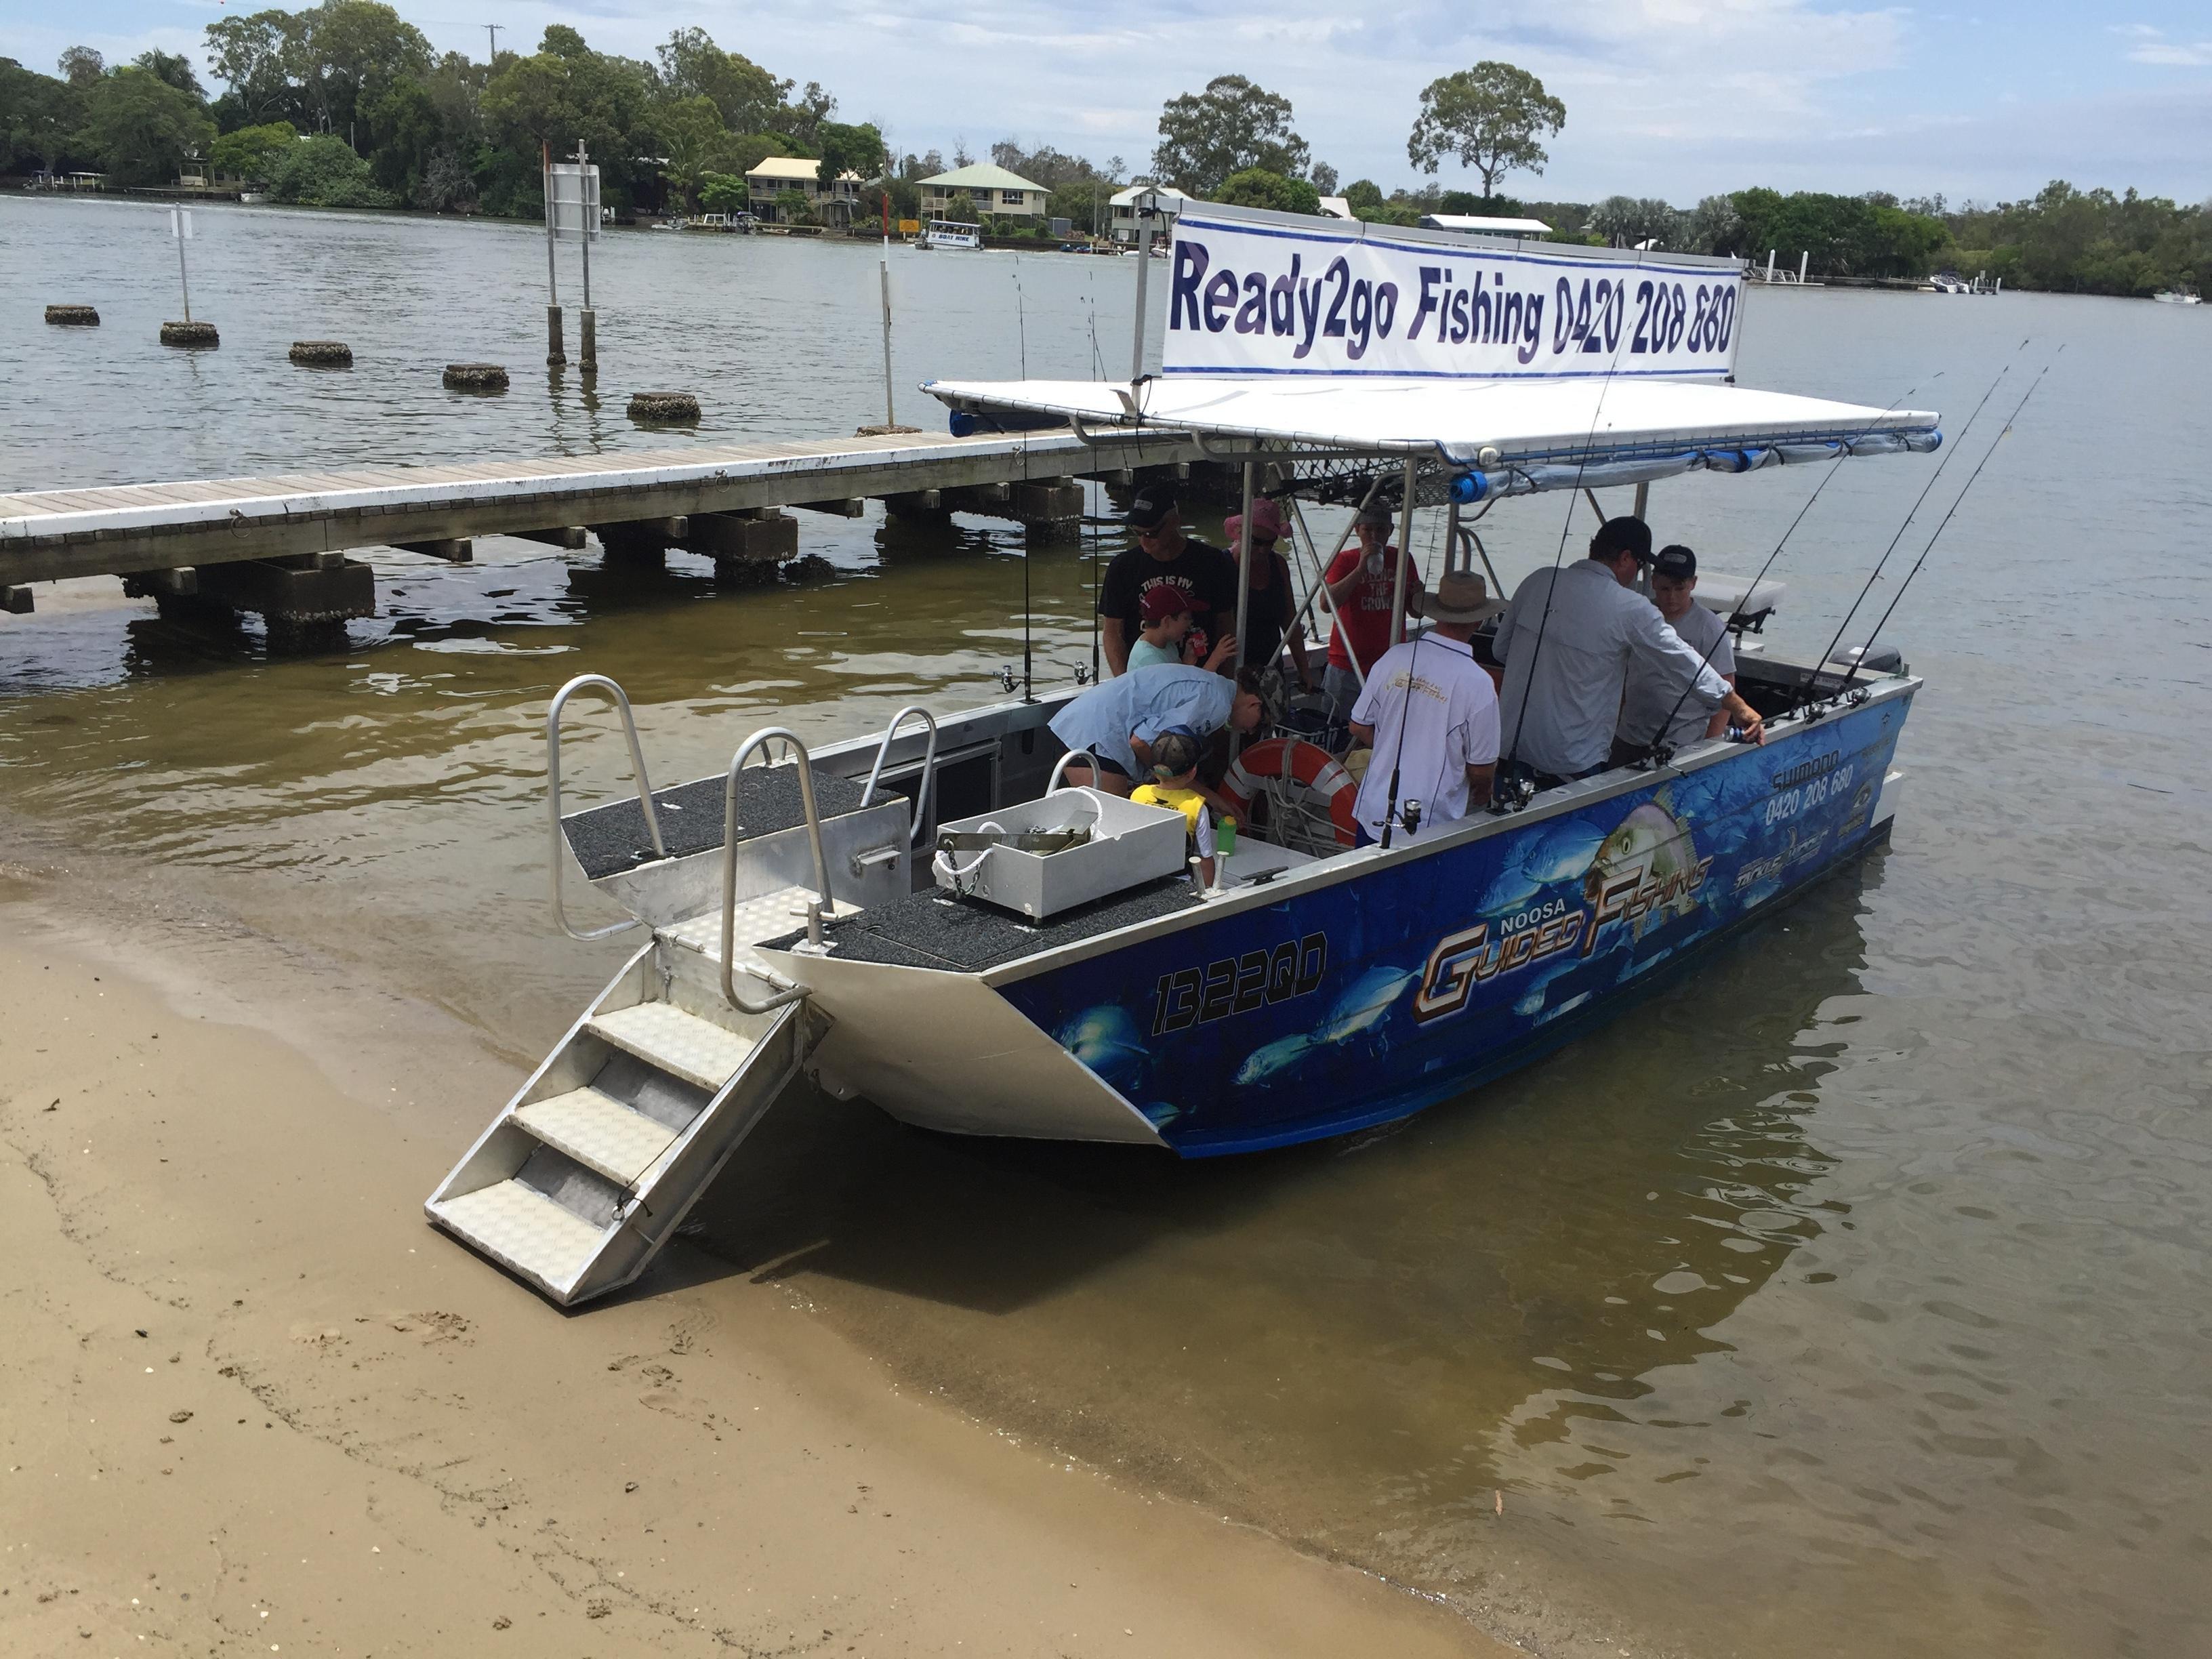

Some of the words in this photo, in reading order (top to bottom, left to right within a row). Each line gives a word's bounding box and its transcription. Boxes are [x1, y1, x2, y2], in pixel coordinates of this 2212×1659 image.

[1169, 239, 1399, 361] Ready2go
[1407, 266, 1545, 365] Fishing
[1553, 276, 1624, 354] 0420
[1631, 279, 1687, 354] 208
[1687, 283, 1736, 354] 680
[1141, 576, 1163, 592] THIS
[1165, 575, 1176, 586] IS
[1177, 576, 1193, 590] MY
[1361, 595, 1394, 611] CROW
[1369, 581, 1389, 597] THE
[1771, 749, 1842, 790] SHIMANO
[1765, 788, 1800, 826] 0420
[1803, 775, 1828, 810] 208
[1830, 764, 1853, 796] 680
[1500, 897, 1566, 936] NOOSA
[1151, 930, 1328, 1037] 1322QD
